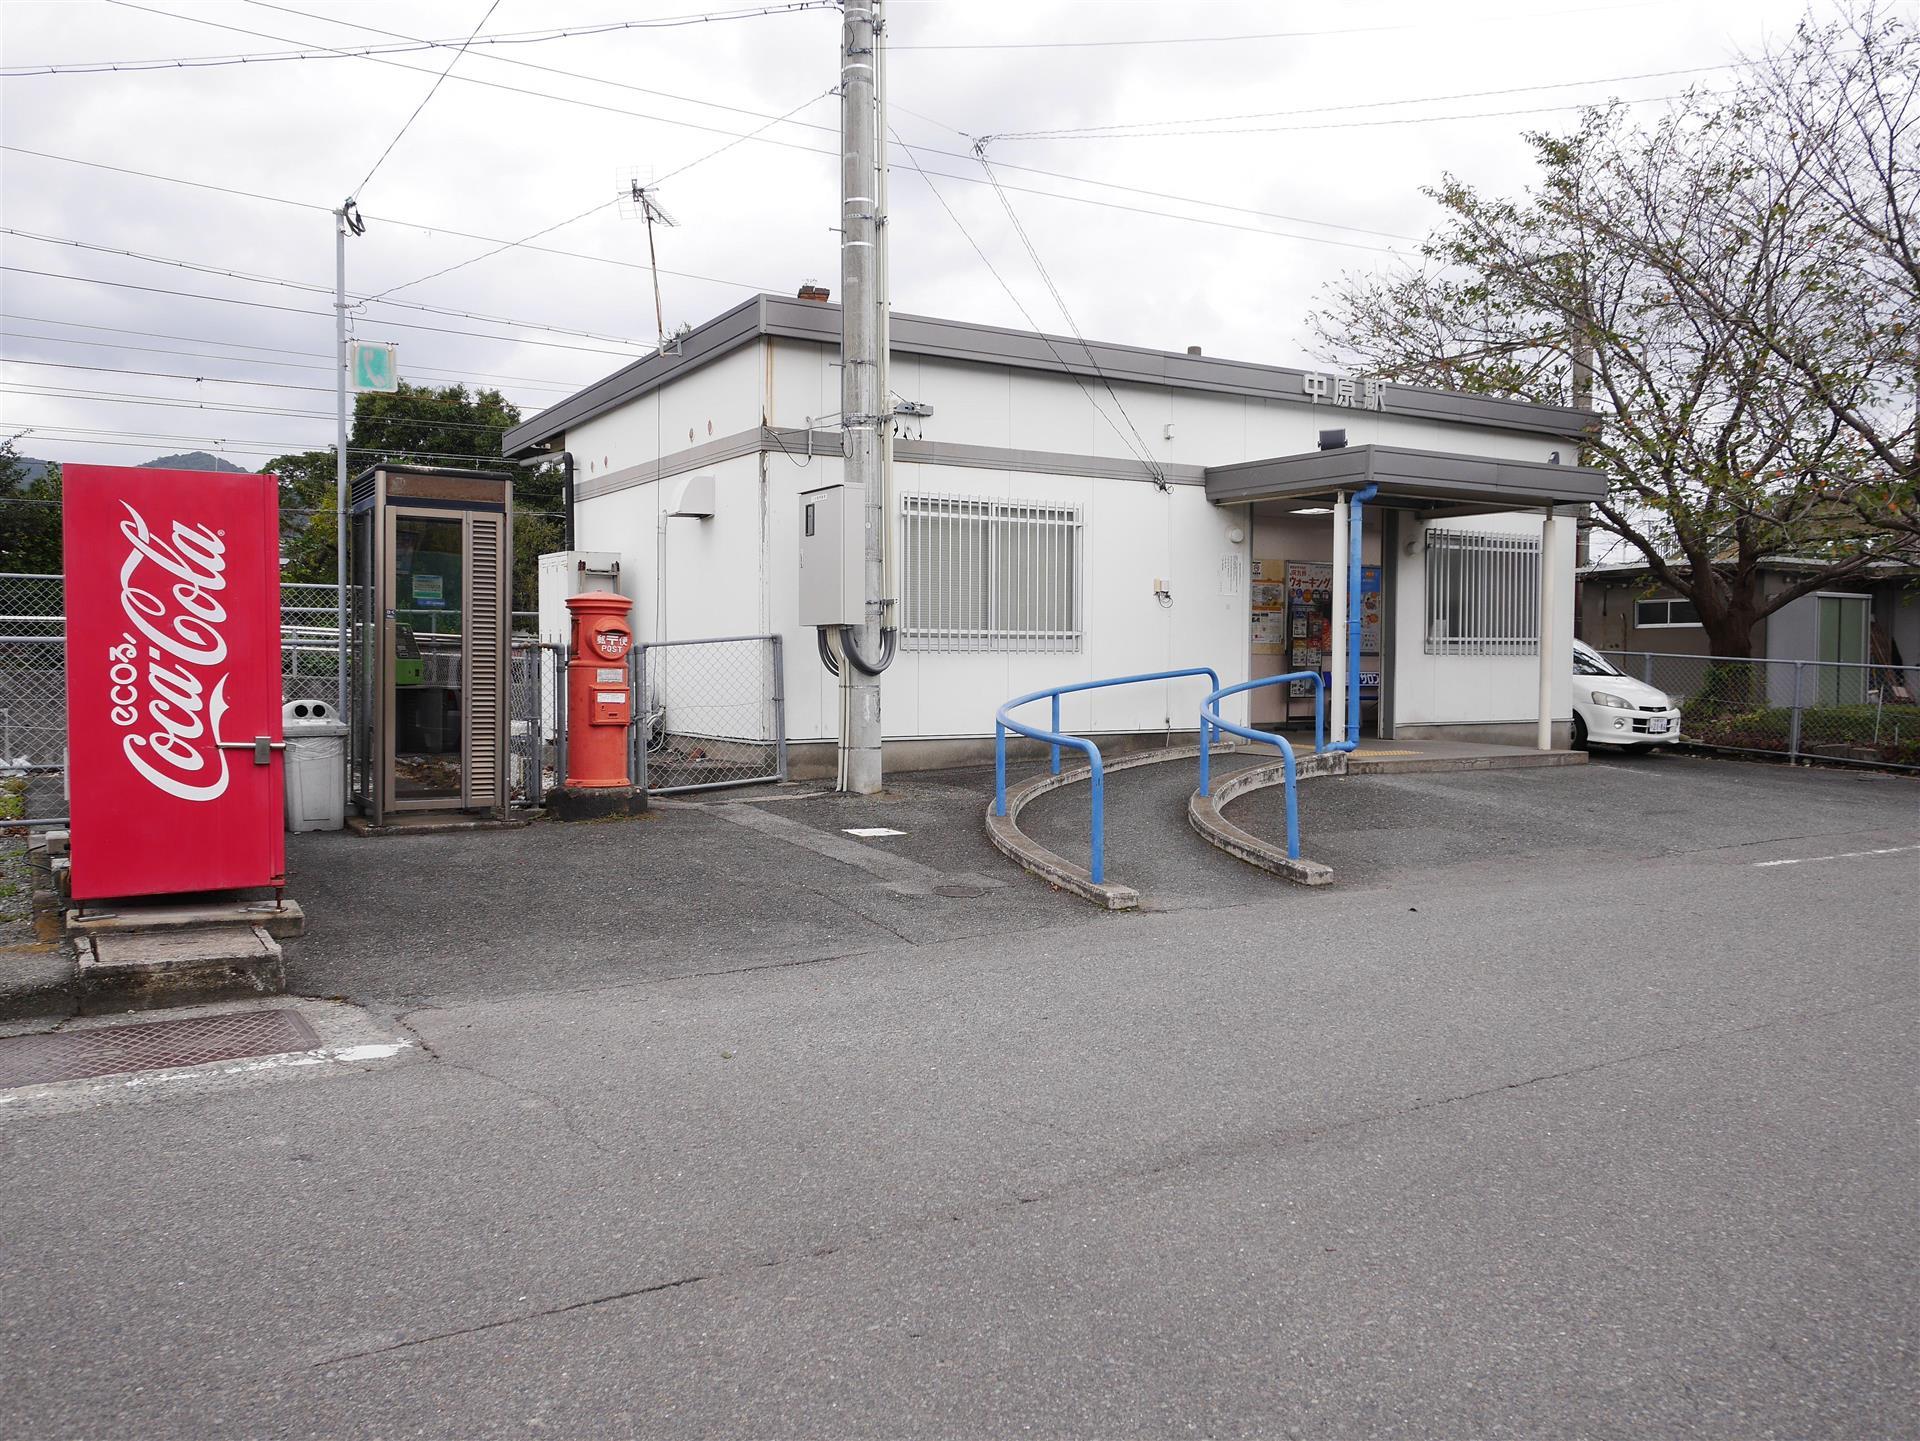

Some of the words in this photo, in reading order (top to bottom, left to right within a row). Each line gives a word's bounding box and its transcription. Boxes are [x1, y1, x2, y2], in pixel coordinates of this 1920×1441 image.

[1304, 370, 1387, 411] 中原駅
[1289, 575, 1331, 588] ウォーキング
[119, 498, 230, 802] Coca-Cola
[601, 645, 623, 653] POST
